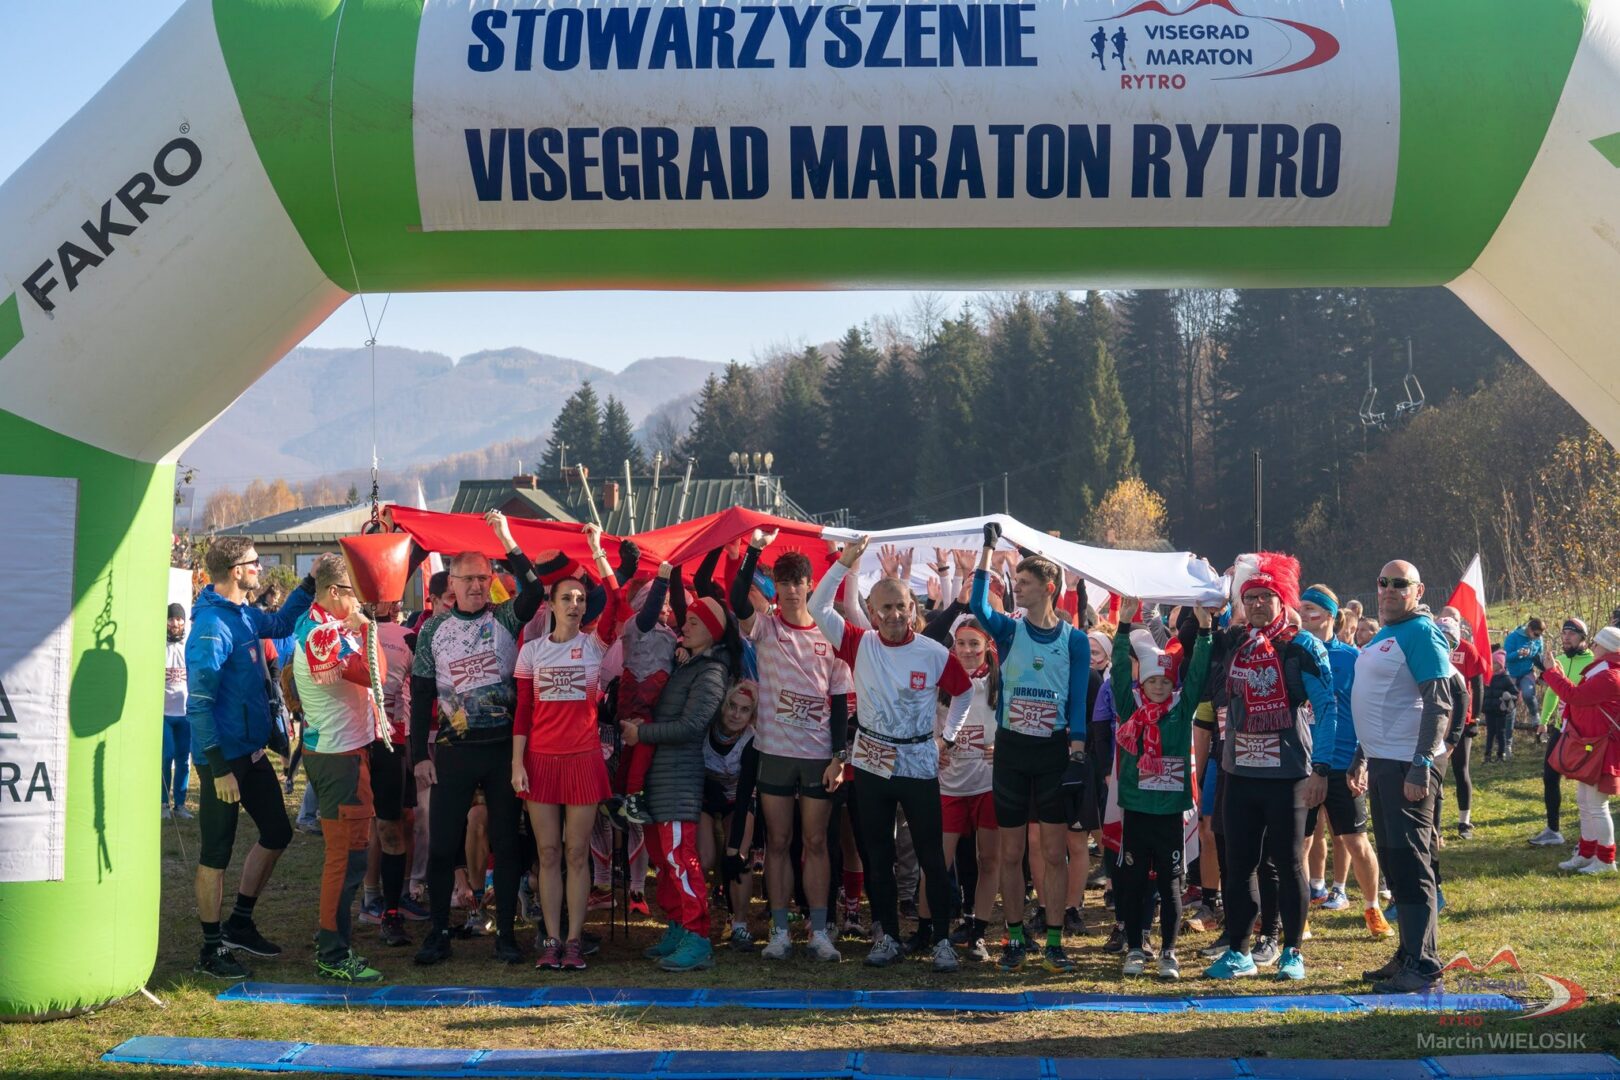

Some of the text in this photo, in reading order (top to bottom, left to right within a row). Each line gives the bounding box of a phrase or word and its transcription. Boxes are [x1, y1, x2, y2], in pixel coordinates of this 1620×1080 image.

[467, 4, 1036, 71] STOWARZYSZENIE
[1145, 25, 1250, 40] VISEGRAD
[1146, 49, 1253, 65] MARATON
[1121, 74, 1185, 90] RYTRO
[465, 123, 1340, 201] VISEGRAD MARATON RYTRO
[468, 666, 481, 675] 65
[555, 678, 569, 686] 110
[795, 704, 807, 713] 77
[1249, 702, 1285, 712] POLSKA
[1026, 712, 1038, 721] 81
[868, 750, 879, 761] 63
[1171, 850, 1180, 864] 9
